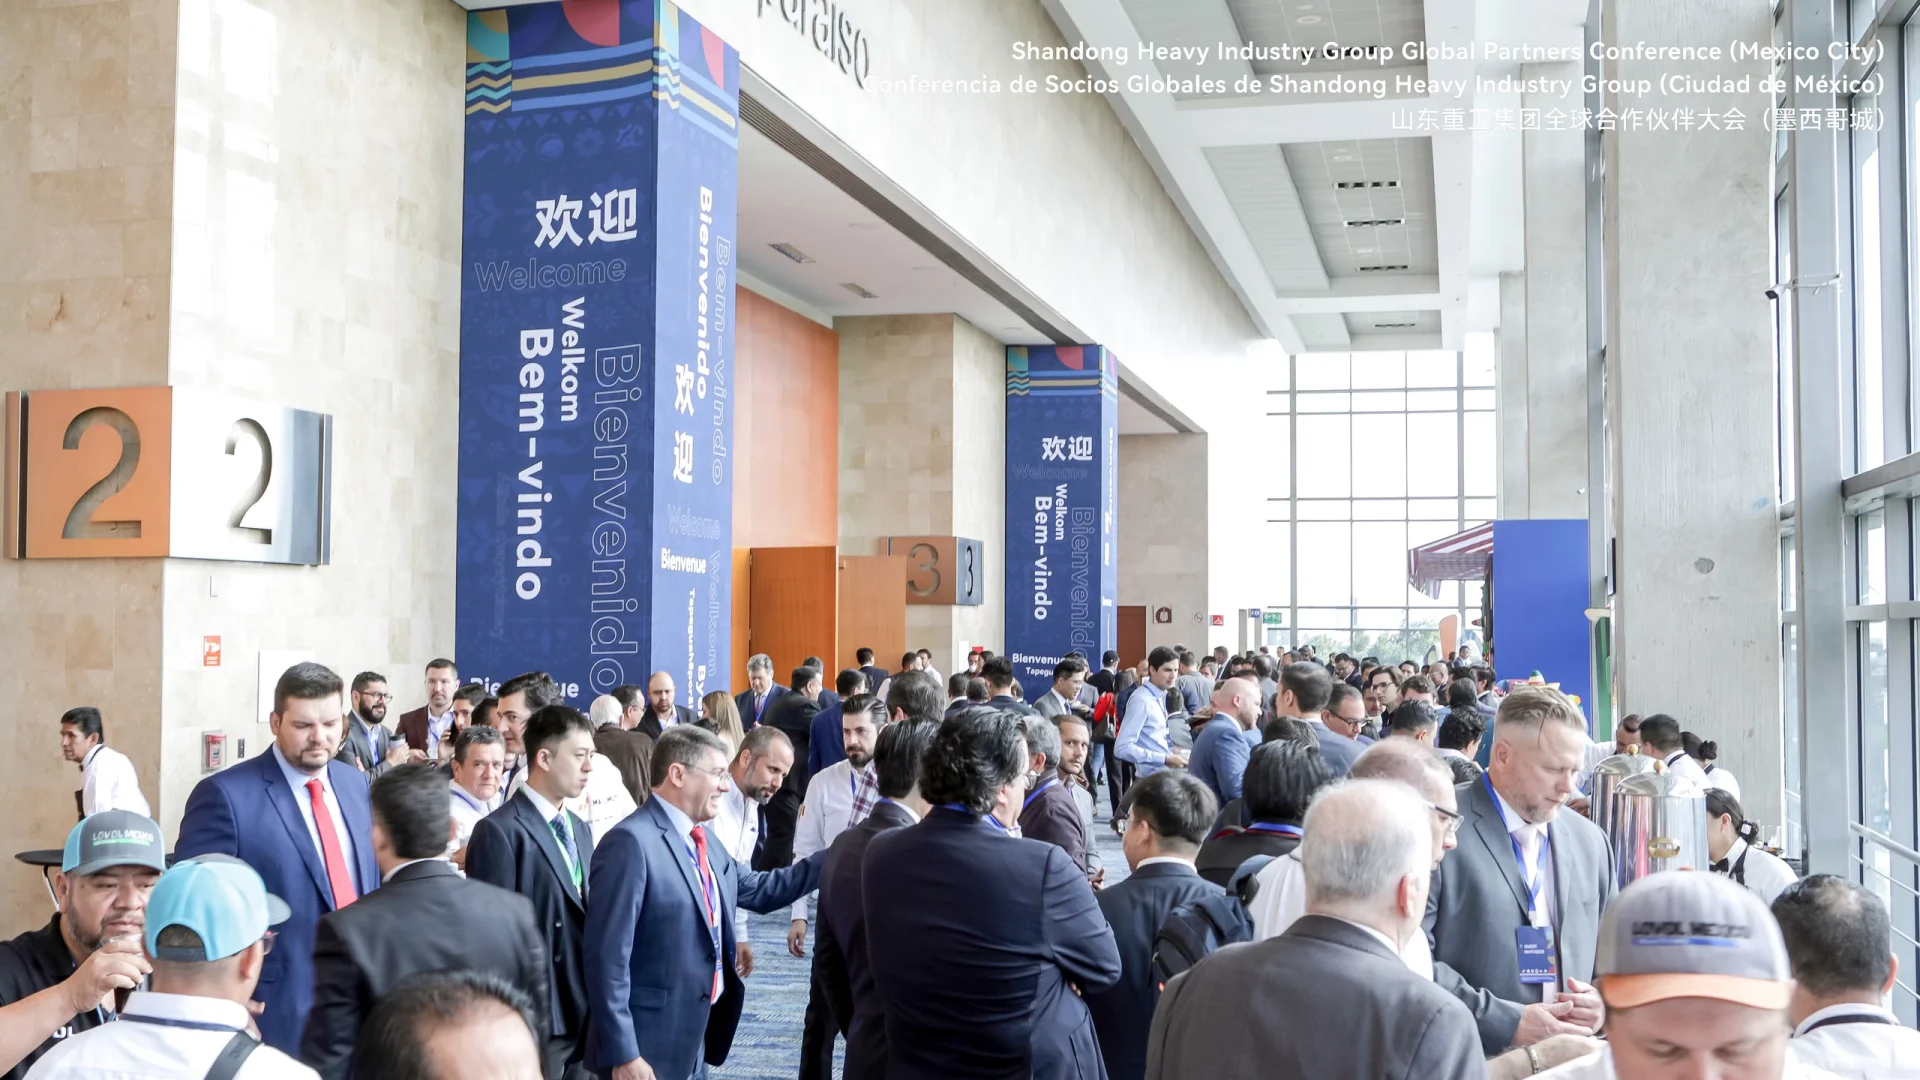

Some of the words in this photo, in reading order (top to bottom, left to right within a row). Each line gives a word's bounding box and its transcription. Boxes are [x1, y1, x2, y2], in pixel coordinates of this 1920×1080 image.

[534, 188, 637, 249] 欢迎
[475, 257, 627, 292] Welcome
[697, 185, 713, 400] Bienvenido
[561, 296, 585, 422] Welkom
[712, 235, 731, 486] Bem-vindo
[674, 363, 695, 484] 欢迎
[1042, 436, 1092, 461] 欢迎
[61, 406, 142, 539] 2
[225, 417, 273, 545] 2
[515, 328, 555, 600] Bem-vindo
[1012, 463, 1088, 480] Welcome
[589, 343, 643, 695] Bienvenido
[667, 504, 720, 540] Welcome
[1055, 483, 1068, 541] Welkom
[661, 547, 707, 574] Bienvenue
[907, 543, 941, 597] 3
[965, 545, 974, 597] 3
[1034, 496, 1053, 620] Bem-vindo
[708, 550, 720, 677] Welkom
[1026, 667, 1054, 678] Tapegu
[92, 829, 123, 841] LOVOL
